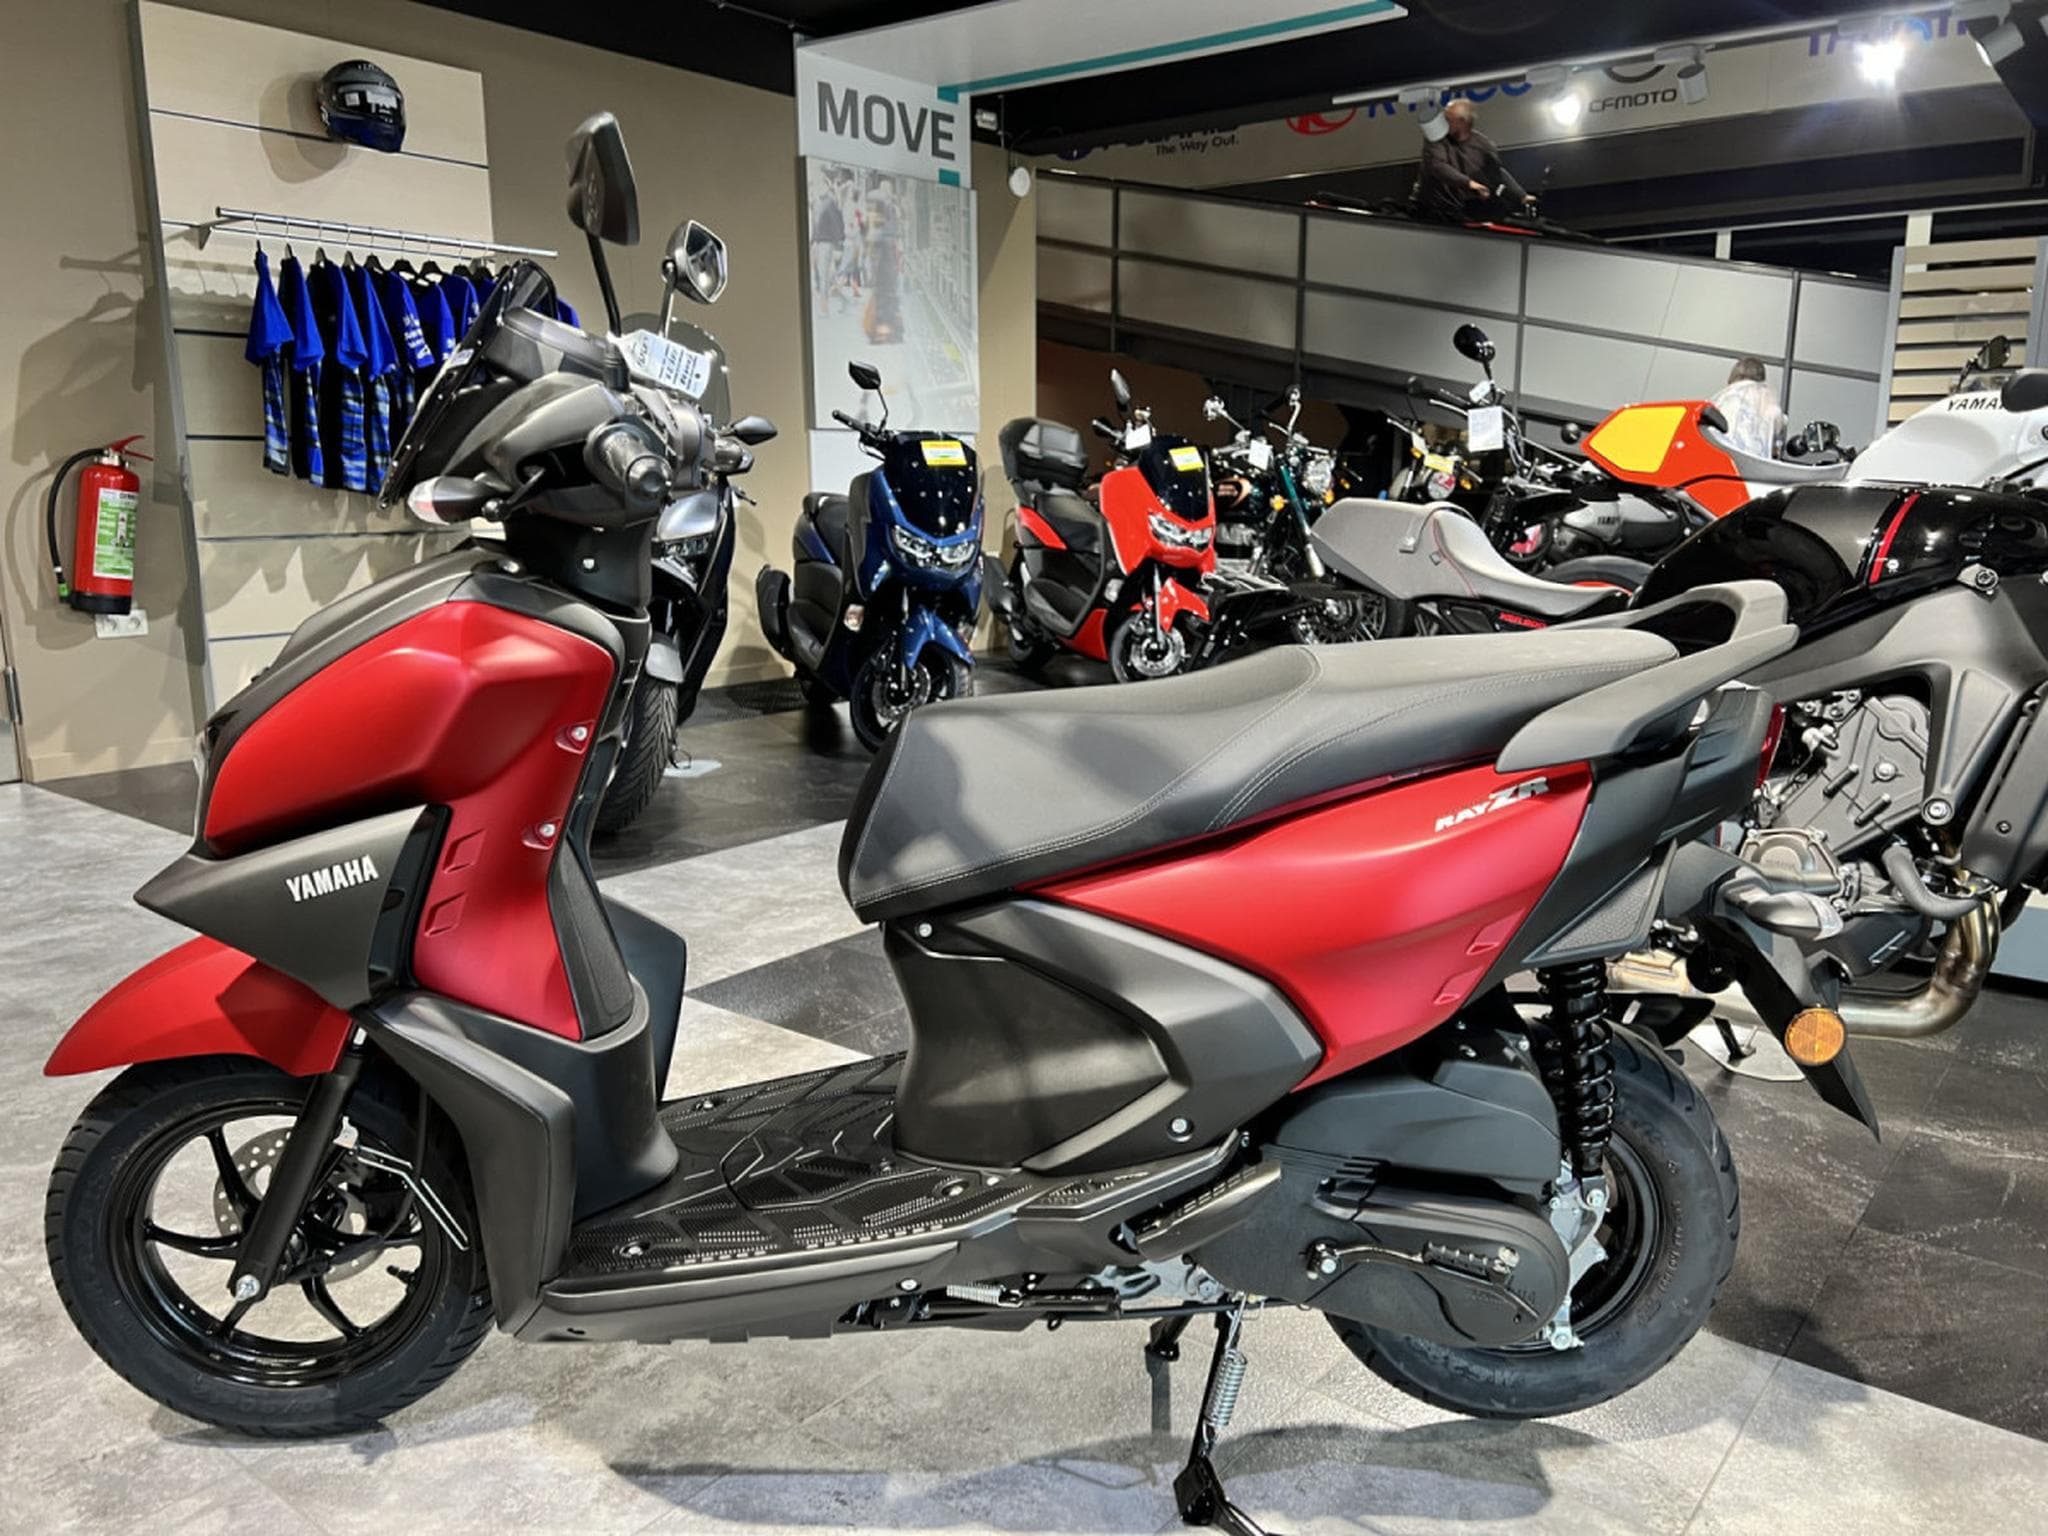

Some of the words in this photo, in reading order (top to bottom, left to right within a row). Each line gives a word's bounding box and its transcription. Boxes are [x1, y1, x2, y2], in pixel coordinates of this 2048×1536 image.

[1588, 88, 1677, 113] CFMOTO
[817, 80, 955, 161] MOVE
[1156, 143, 1176, 156] The
[1179, 139, 1208, 153] Way
[1947, 397, 2004, 411] YAMA
[286, 853, 379, 902] YAMAHA
